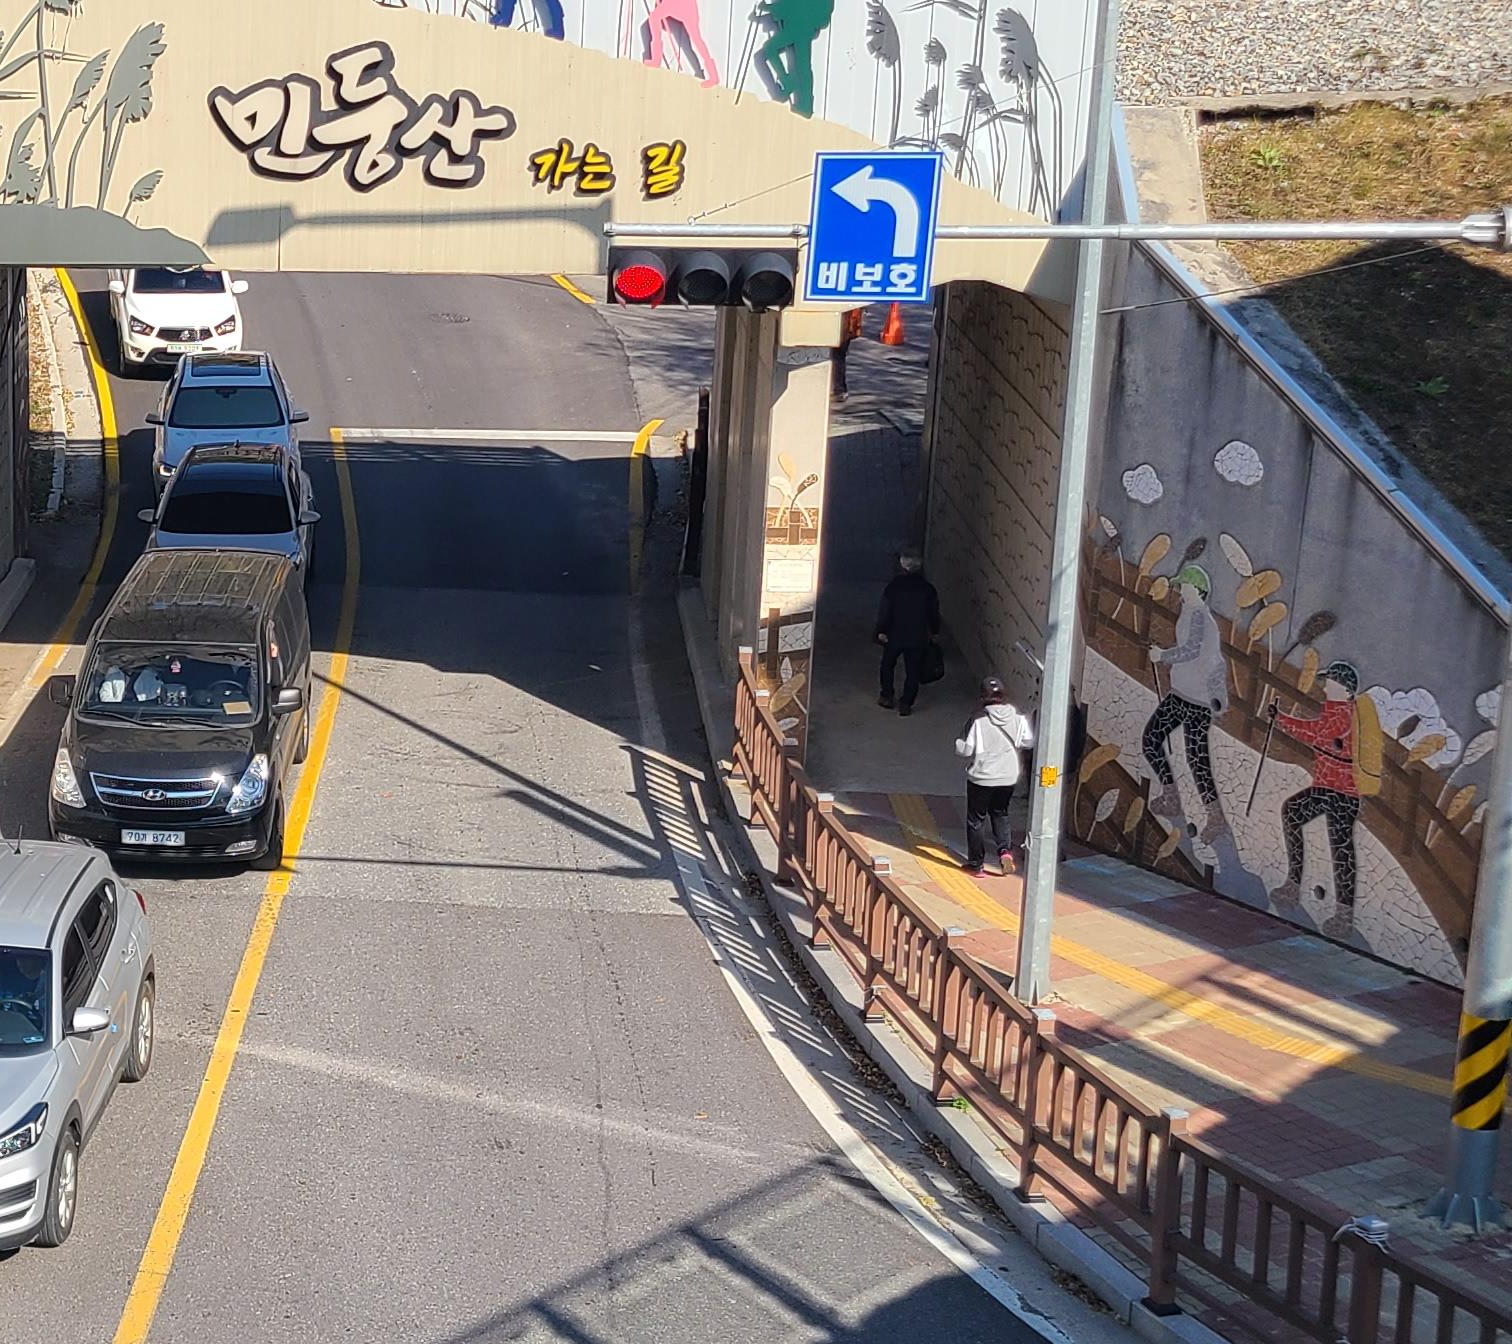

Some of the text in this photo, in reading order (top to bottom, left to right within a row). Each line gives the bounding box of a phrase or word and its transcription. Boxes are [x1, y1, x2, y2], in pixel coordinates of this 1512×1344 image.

[208, 41, 687, 201] 민둥산 가는 길
[817, 261, 918, 293] 비보호
[152, 833, 179, 844] 8742
